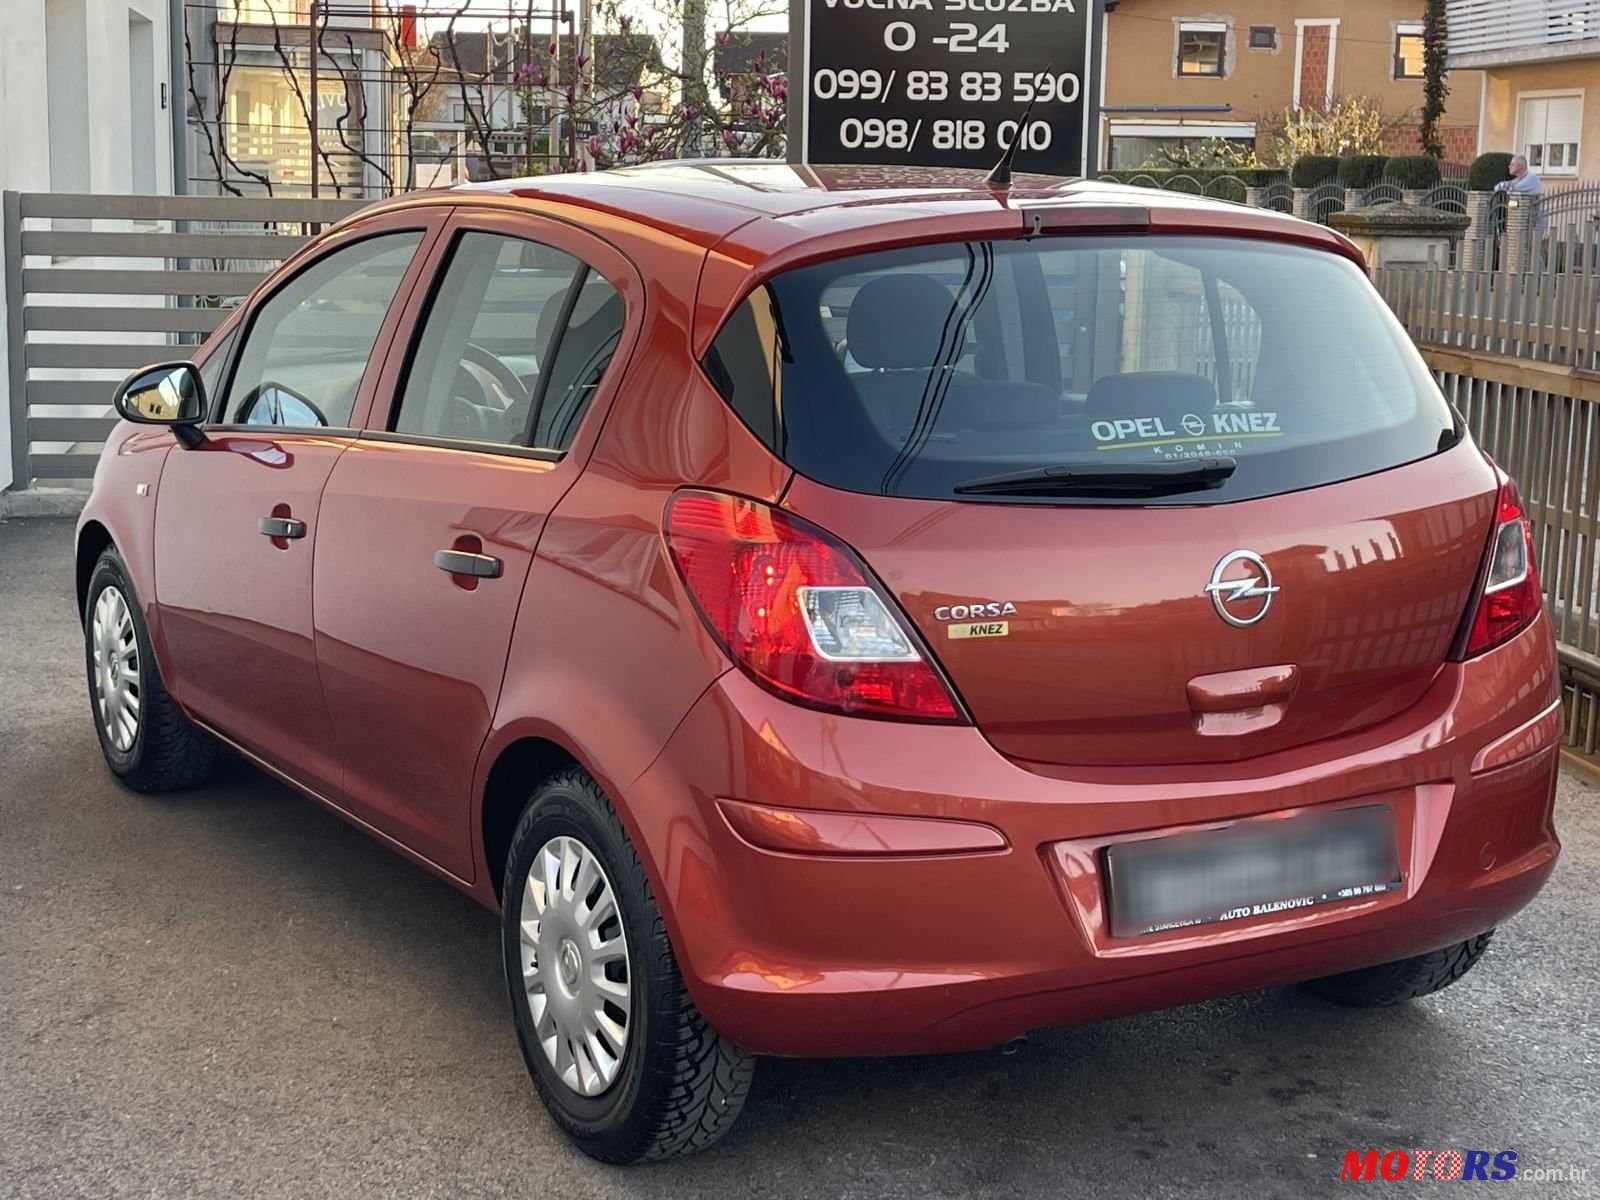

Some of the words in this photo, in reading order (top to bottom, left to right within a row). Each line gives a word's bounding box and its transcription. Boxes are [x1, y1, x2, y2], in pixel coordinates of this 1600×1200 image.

[813, 68, 897, 104] 099/
[906, 70, 949, 101] 83
[960, 71, 1002, 102] 83
[1013, 72, 1080, 103] 590
[840, 118, 922, 152] 098/
[932, 119, 986, 150] 818
[997, 120, 1052, 151] 010
[1091, 417, 1176, 441] OPEL
[1212, 412, 1281, 434] KNEZ
[934, 601, 1018, 620] CORSA
[969, 623, 1004, 635] KNEZ
[1219, 906, 1251, 921] AUTO
